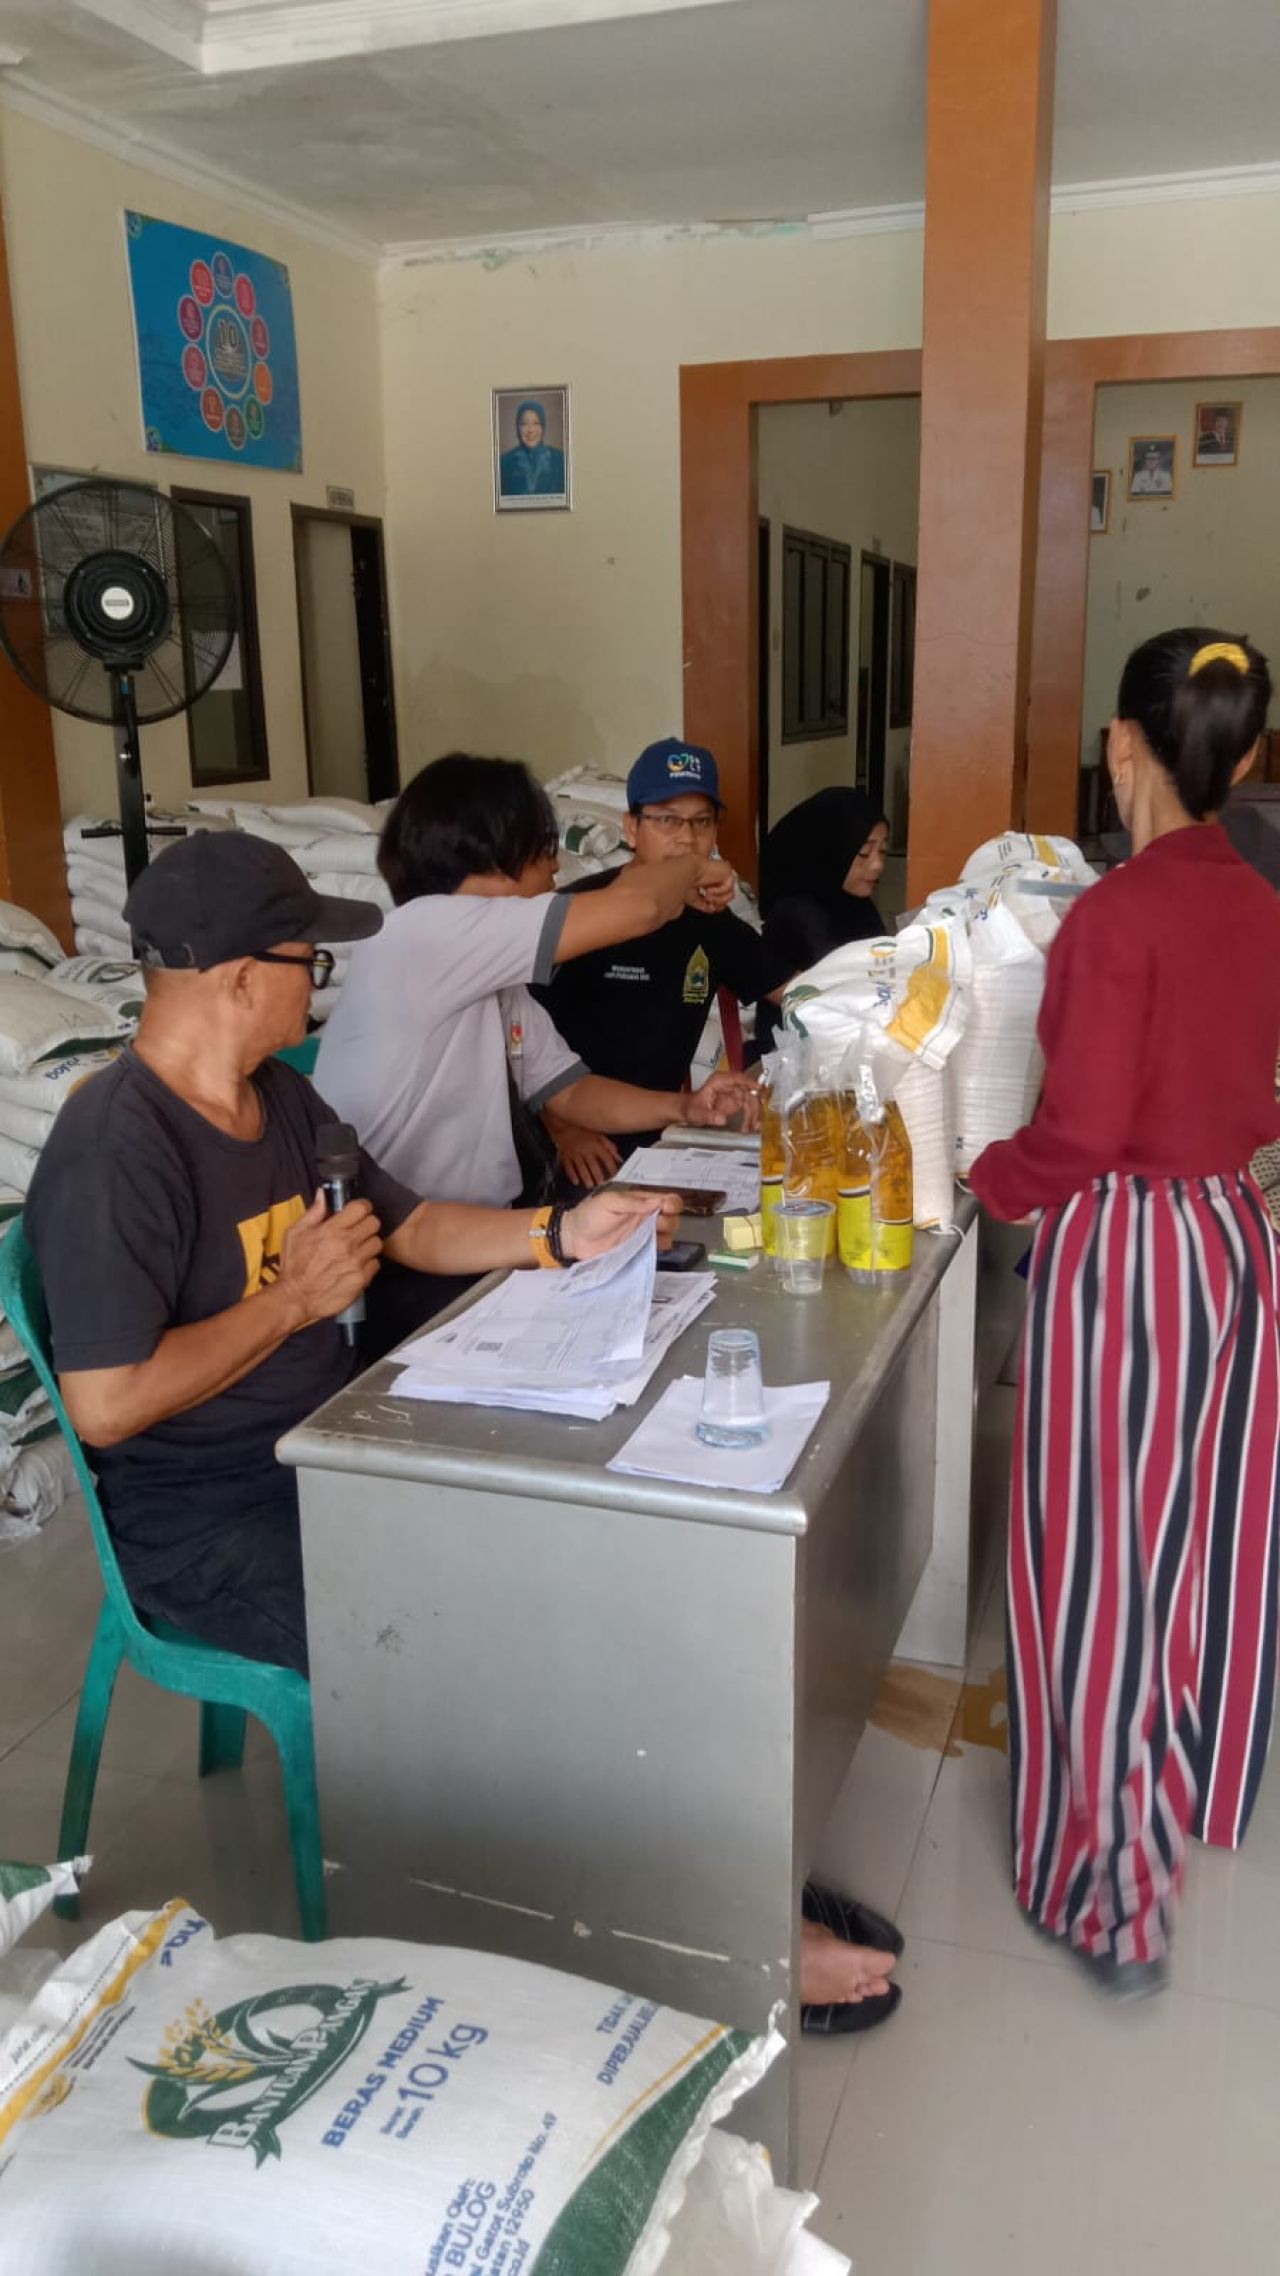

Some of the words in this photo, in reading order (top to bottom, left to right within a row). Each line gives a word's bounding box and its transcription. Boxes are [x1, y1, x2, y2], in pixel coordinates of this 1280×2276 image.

[321, 2072, 387, 2148] BERAS
[377, 1996, 445, 2069] MEDIUM
[398, 2063, 449, 2100] 10
[425, 2023, 488, 2059] kg
[444, 2181, 496, 2267] BULOG
[475, 2214, 505, 2260] Gatot
[496, 2155, 535, 2212] Subroto
[504, 2188, 535, 2236] 12950
